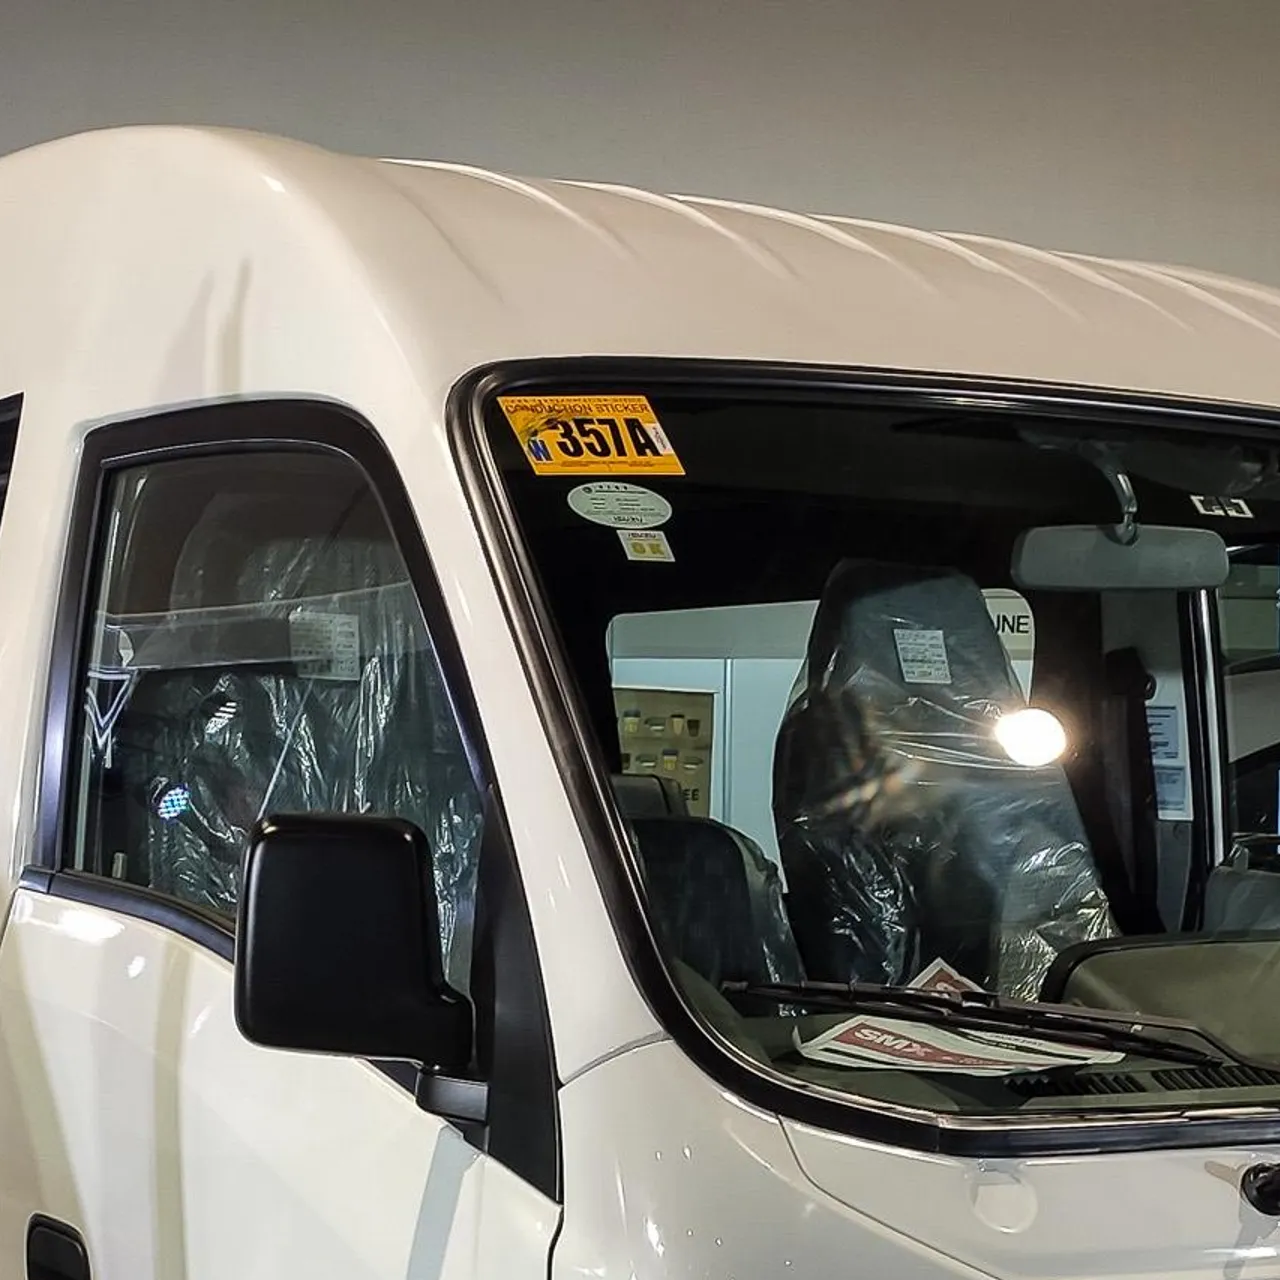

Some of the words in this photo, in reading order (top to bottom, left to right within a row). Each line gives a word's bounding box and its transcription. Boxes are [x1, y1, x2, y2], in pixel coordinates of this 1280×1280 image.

[596, 403, 650, 413] STICKER
[548, 418, 663, 457] 357A
[853, 1027, 934, 1058] SMX
